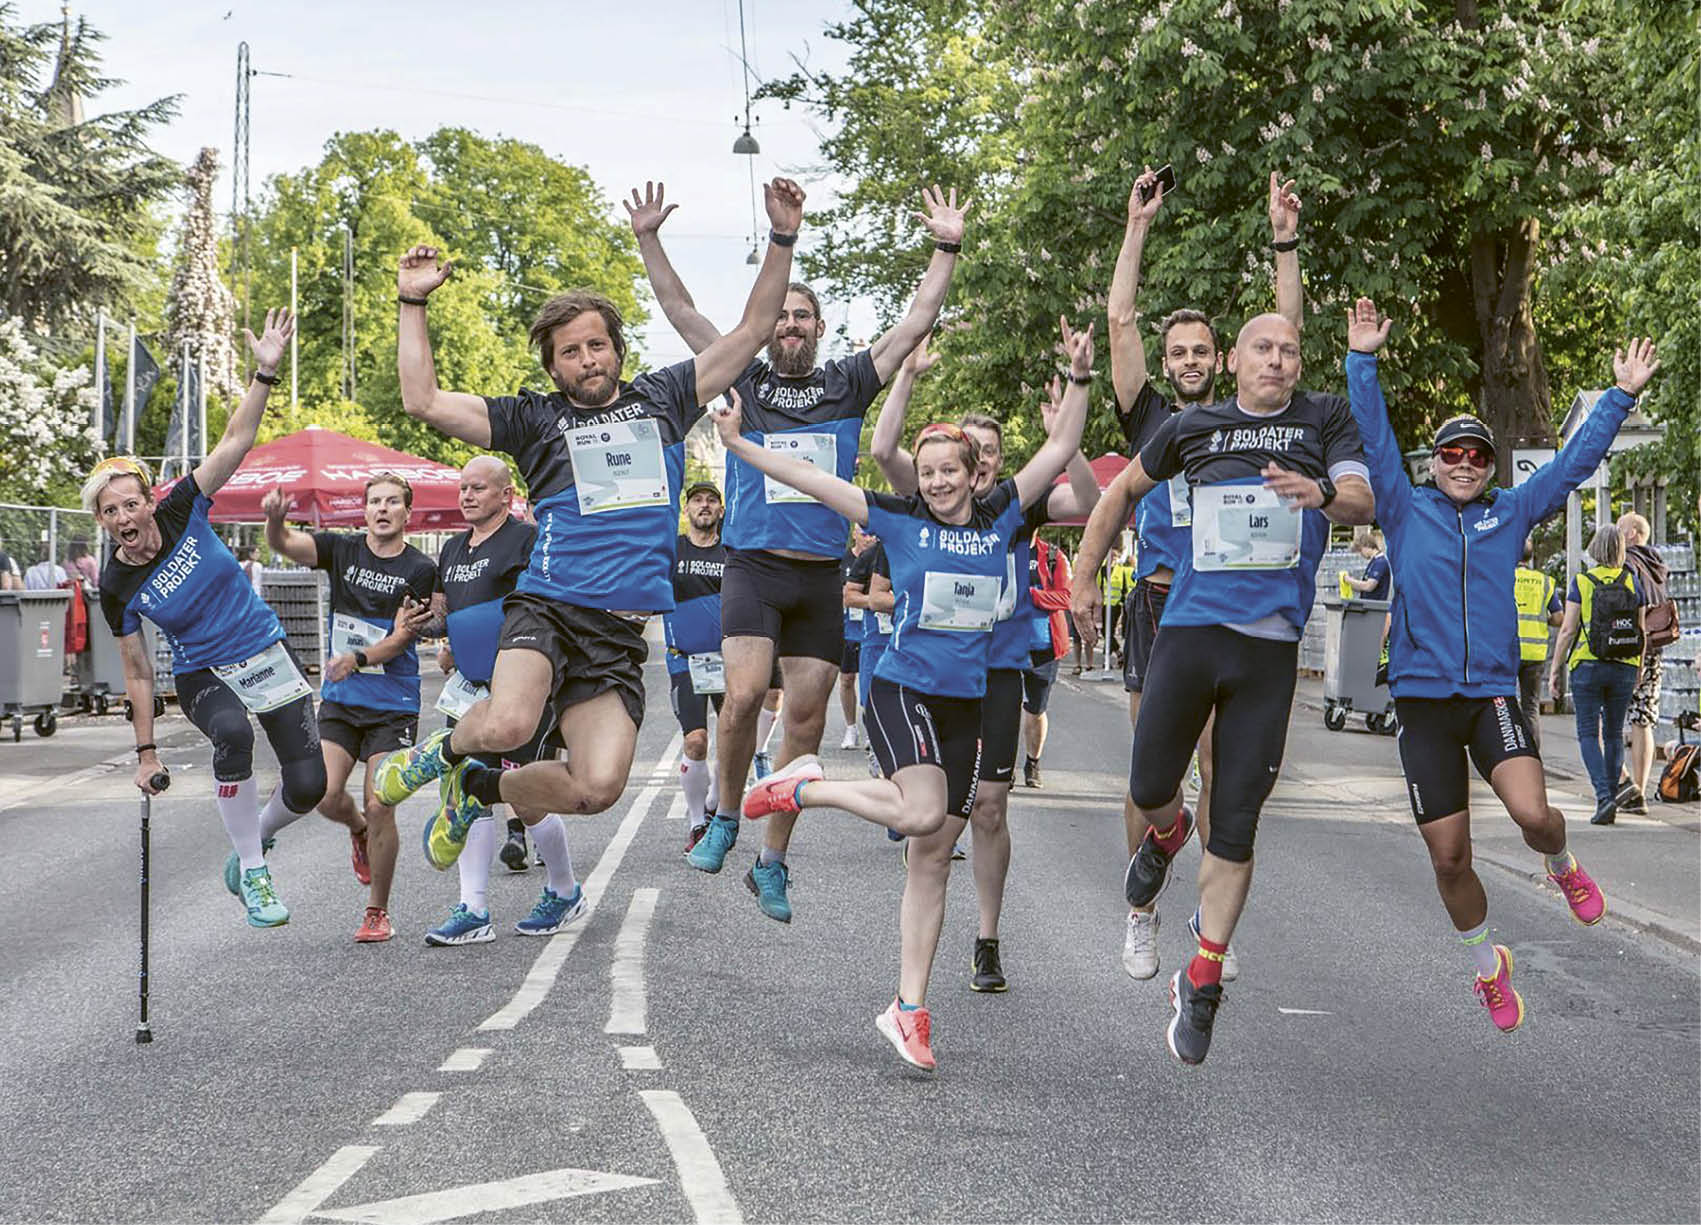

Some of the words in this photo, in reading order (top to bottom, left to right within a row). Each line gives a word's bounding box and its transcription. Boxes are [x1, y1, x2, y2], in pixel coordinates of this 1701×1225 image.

[775, 386, 825, 400] SOLDATER
[771, 395, 818, 409] PROJEKT
[1233, 426, 1304, 442] SOLDATER
[1230, 438, 1291, 452] PROJEKT
[605, 452, 632, 467] Rune
[1249, 513, 1269, 528] Lars
[939, 542, 994, 556] PROJEKT
[152, 536, 198, 589] SOLDATER
[690, 560, 726, 569] SOLDATE
[160, 550, 202, 598] PROJEKT
[356, 577, 395, 595] PROJEKT
[954, 581, 976, 598] Tanja
[239, 666, 276, 690] Marianne
[1496, 706, 1518, 752] DANMARK
[961, 751, 983, 814] DANMARK
